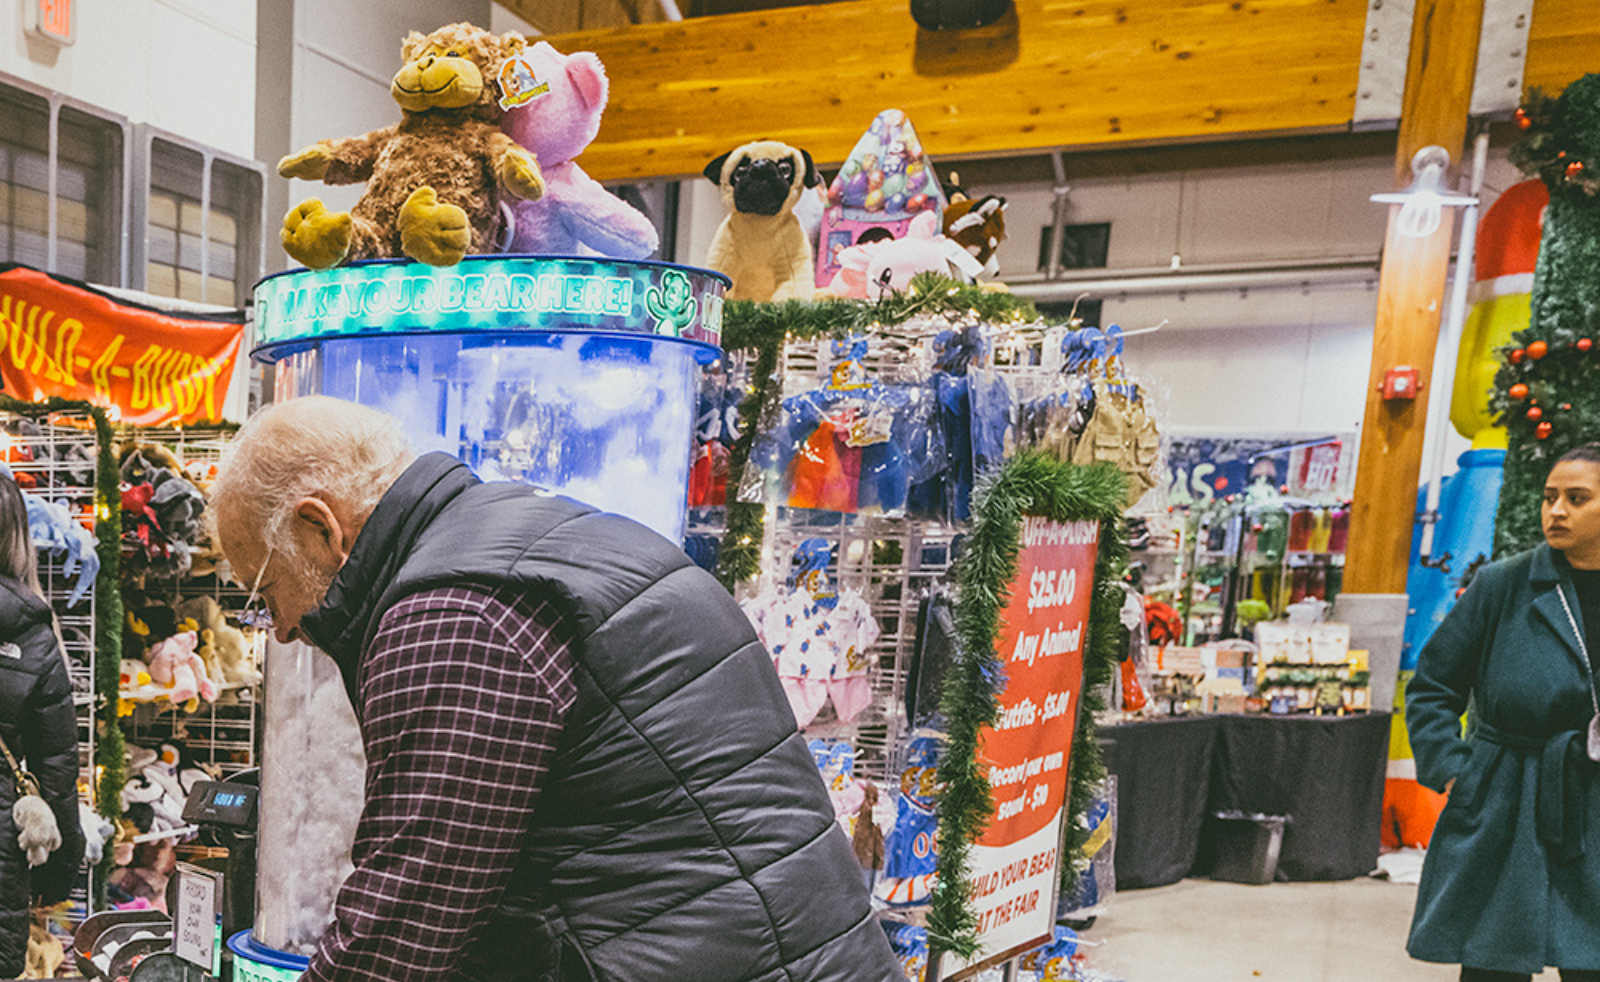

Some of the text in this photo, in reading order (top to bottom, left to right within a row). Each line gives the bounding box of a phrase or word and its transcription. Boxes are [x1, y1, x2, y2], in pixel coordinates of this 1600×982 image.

[278, 274, 632, 323] MAKE YOUR BEAR HERE!
[1027, 566, 1076, 614] $25.00
[1011, 621, 1082, 667] Any Animal
[994, 697, 1037, 731] Outfits
[988, 758, 1027, 787] Record
[970, 871, 999, 902] UILD
[1000, 858, 1028, 890] YOUR
[975, 889, 1039, 934] AT THE FAIR
